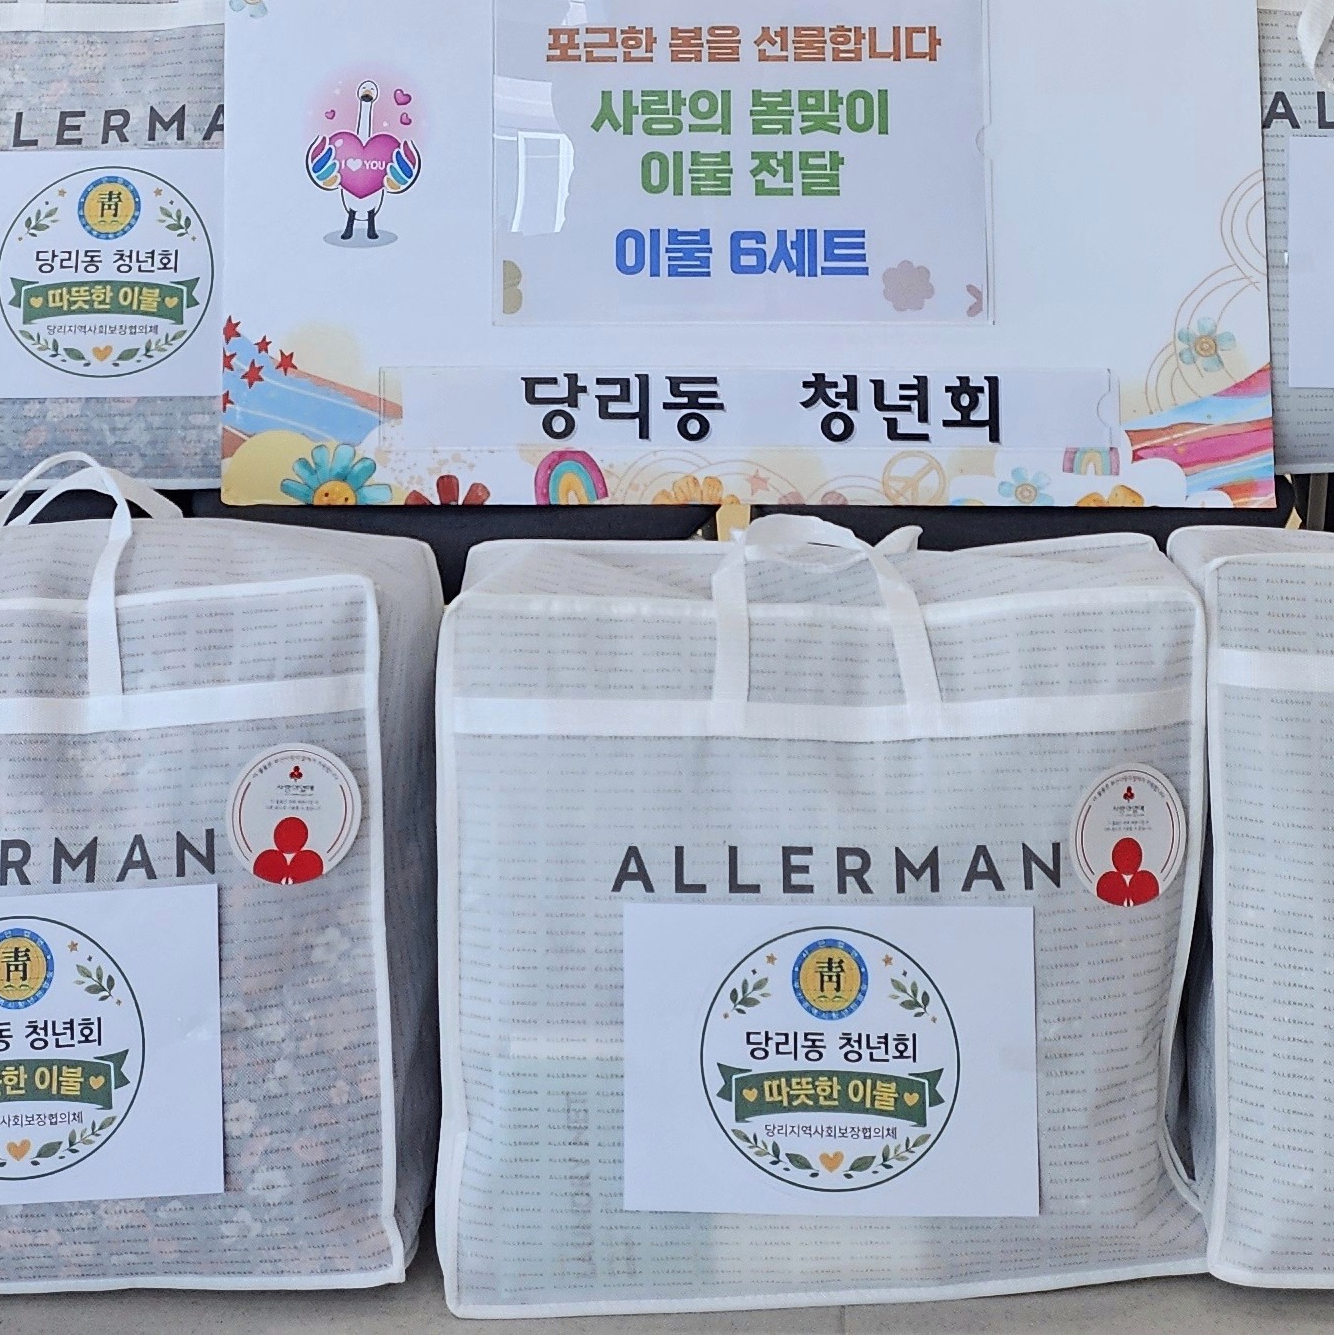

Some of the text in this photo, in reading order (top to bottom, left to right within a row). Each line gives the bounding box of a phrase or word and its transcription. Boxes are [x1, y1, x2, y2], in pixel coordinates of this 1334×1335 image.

[545, 24, 942, 63] 포근한 봄을 선물합니다
[590, 88, 889, 136] 사랑의 봄맞이
[363, 160, 386, 171] YOU
[640, 150, 845, 197] 이불 전달
[35, 248, 179, 274] 당리동 청년회
[615, 227, 870, 278] 이불 6세트
[48, 285, 113, 310] 따뜻한
[520, 372, 1001, 444] 당리동 청년회
[611, 842, 1060, 894] ALLERMAN
[24, 1016, 102, 1051] 청년회
[745, 1030, 917, 1064] 당리동 청년회
[35, 1066, 83, 1095] 이불
[764, 1078, 898, 1110] 따뜻한 이불
[764, 1123, 898, 1140] 당리지역사회보장협의체
